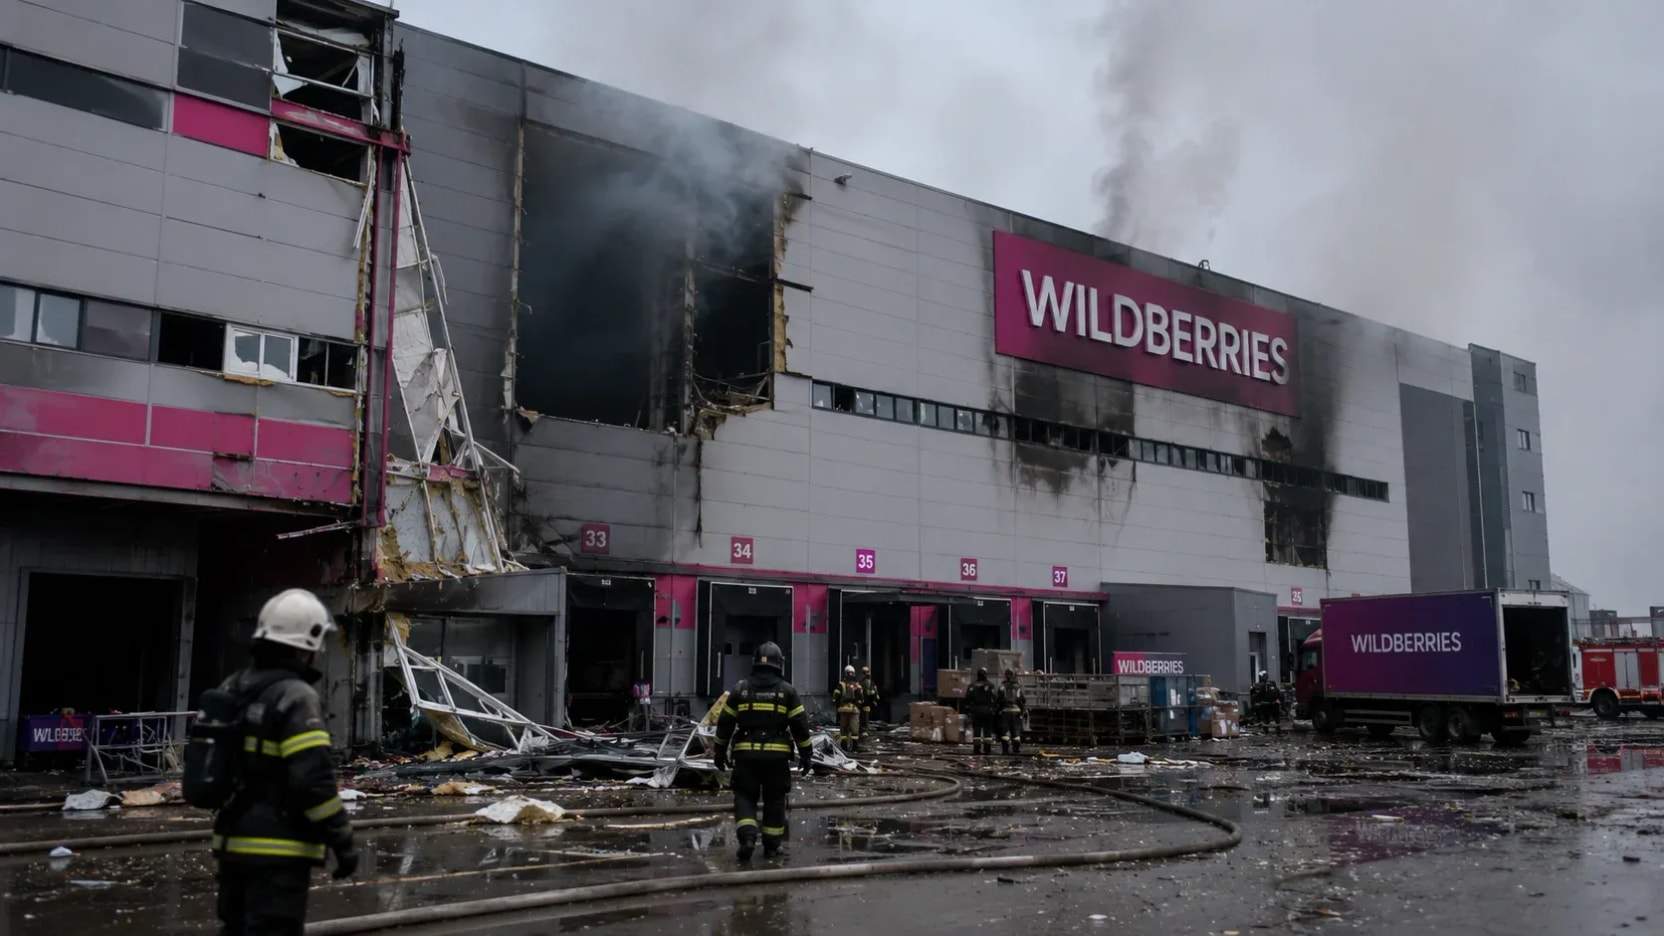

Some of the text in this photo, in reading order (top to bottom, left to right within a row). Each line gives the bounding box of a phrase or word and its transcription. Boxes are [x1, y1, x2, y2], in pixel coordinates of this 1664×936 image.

[1020, 269, 1290, 385] WILDBERRIES
[585, 530, 607, 548] 33
[733, 543, 752, 559] 34
[858, 554, 874, 569] 35
[962, 563, 976, 576] 36
[1054, 570, 1066, 583] 37
[1351, 631, 1462, 653] WILDBERRIES
[1117, 659, 1184, 674] WILDBERRIES
